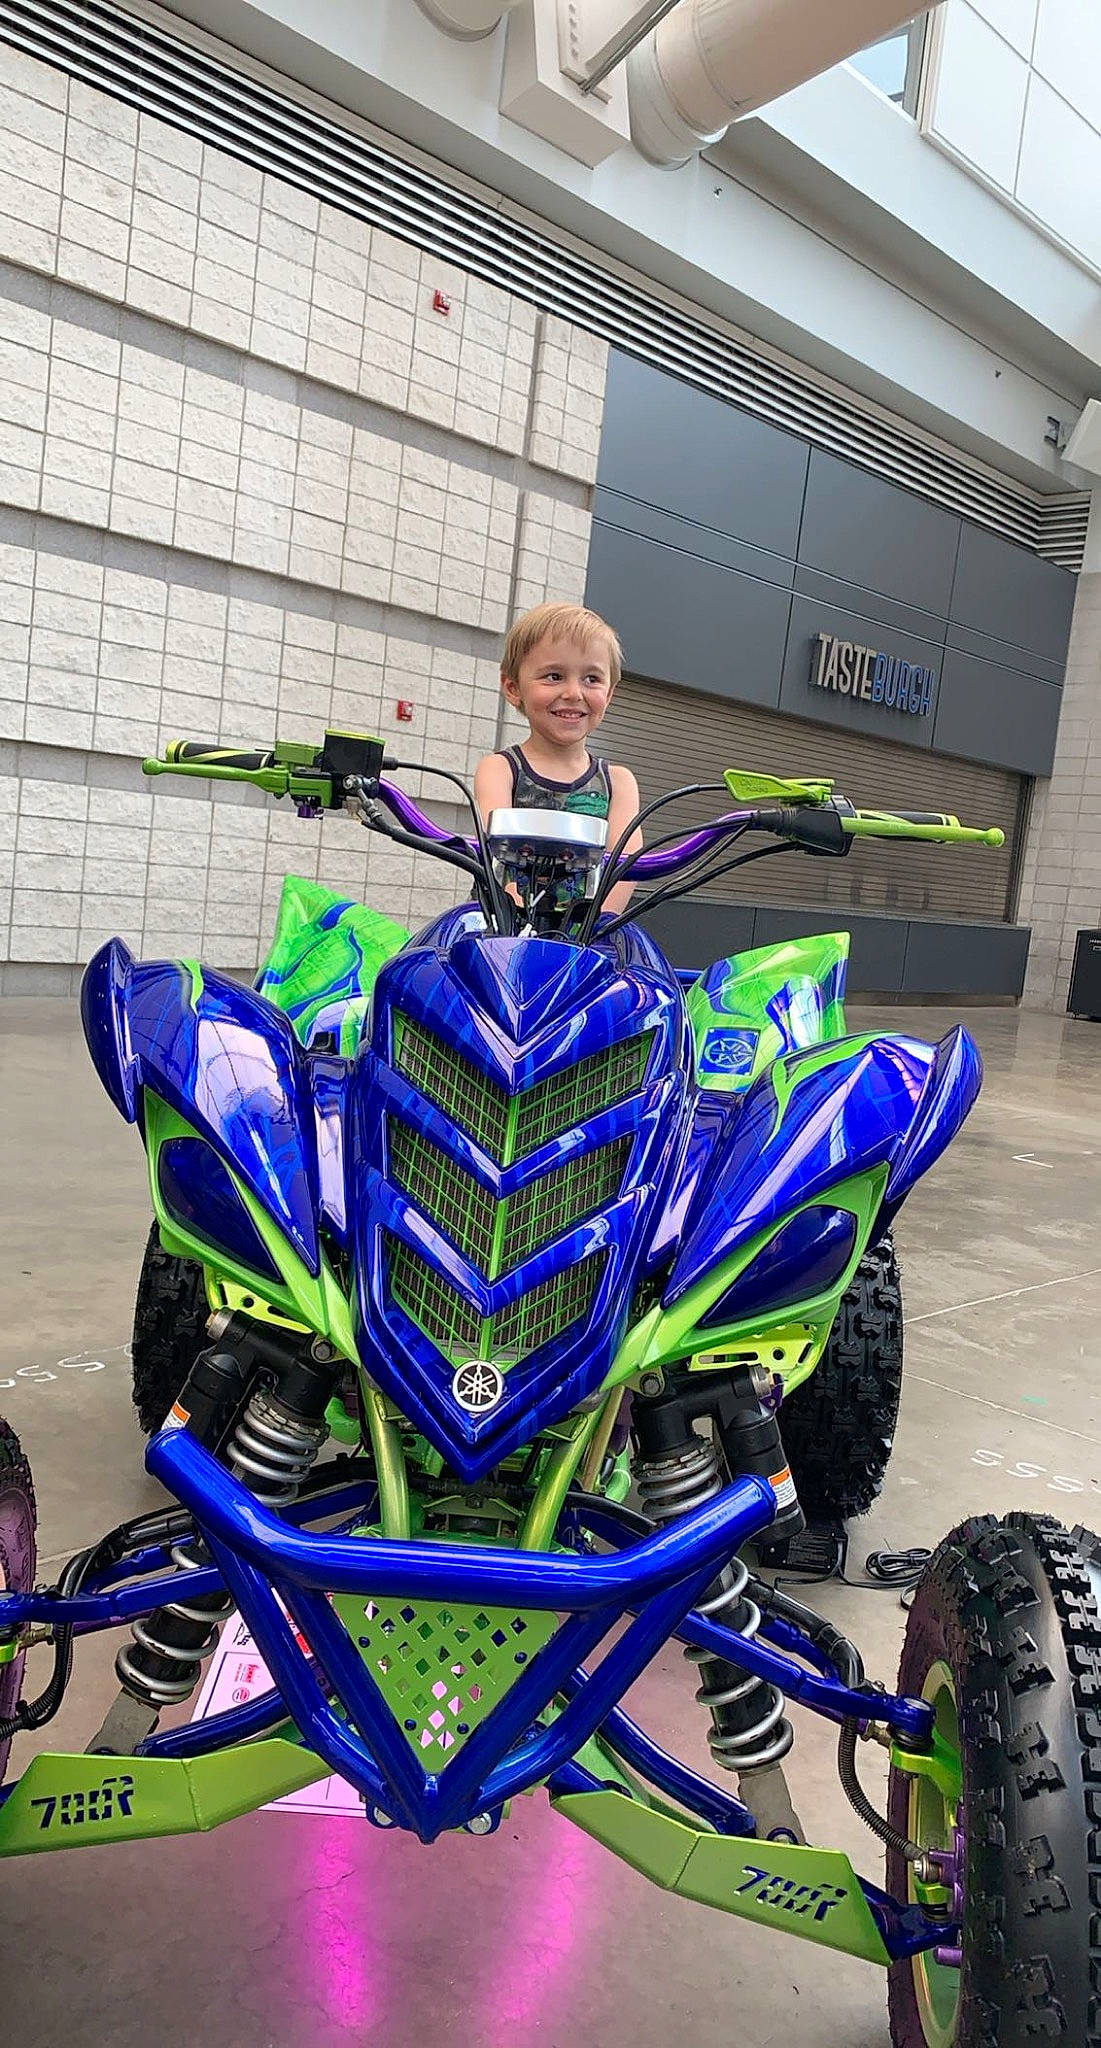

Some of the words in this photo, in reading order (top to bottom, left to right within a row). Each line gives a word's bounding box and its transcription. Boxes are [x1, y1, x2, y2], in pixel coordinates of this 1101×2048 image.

[817, 632, 935, 717] TASTEBURGH
[31, 1775, 134, 1830] 700R
[734, 1865, 848, 1922] 700R
